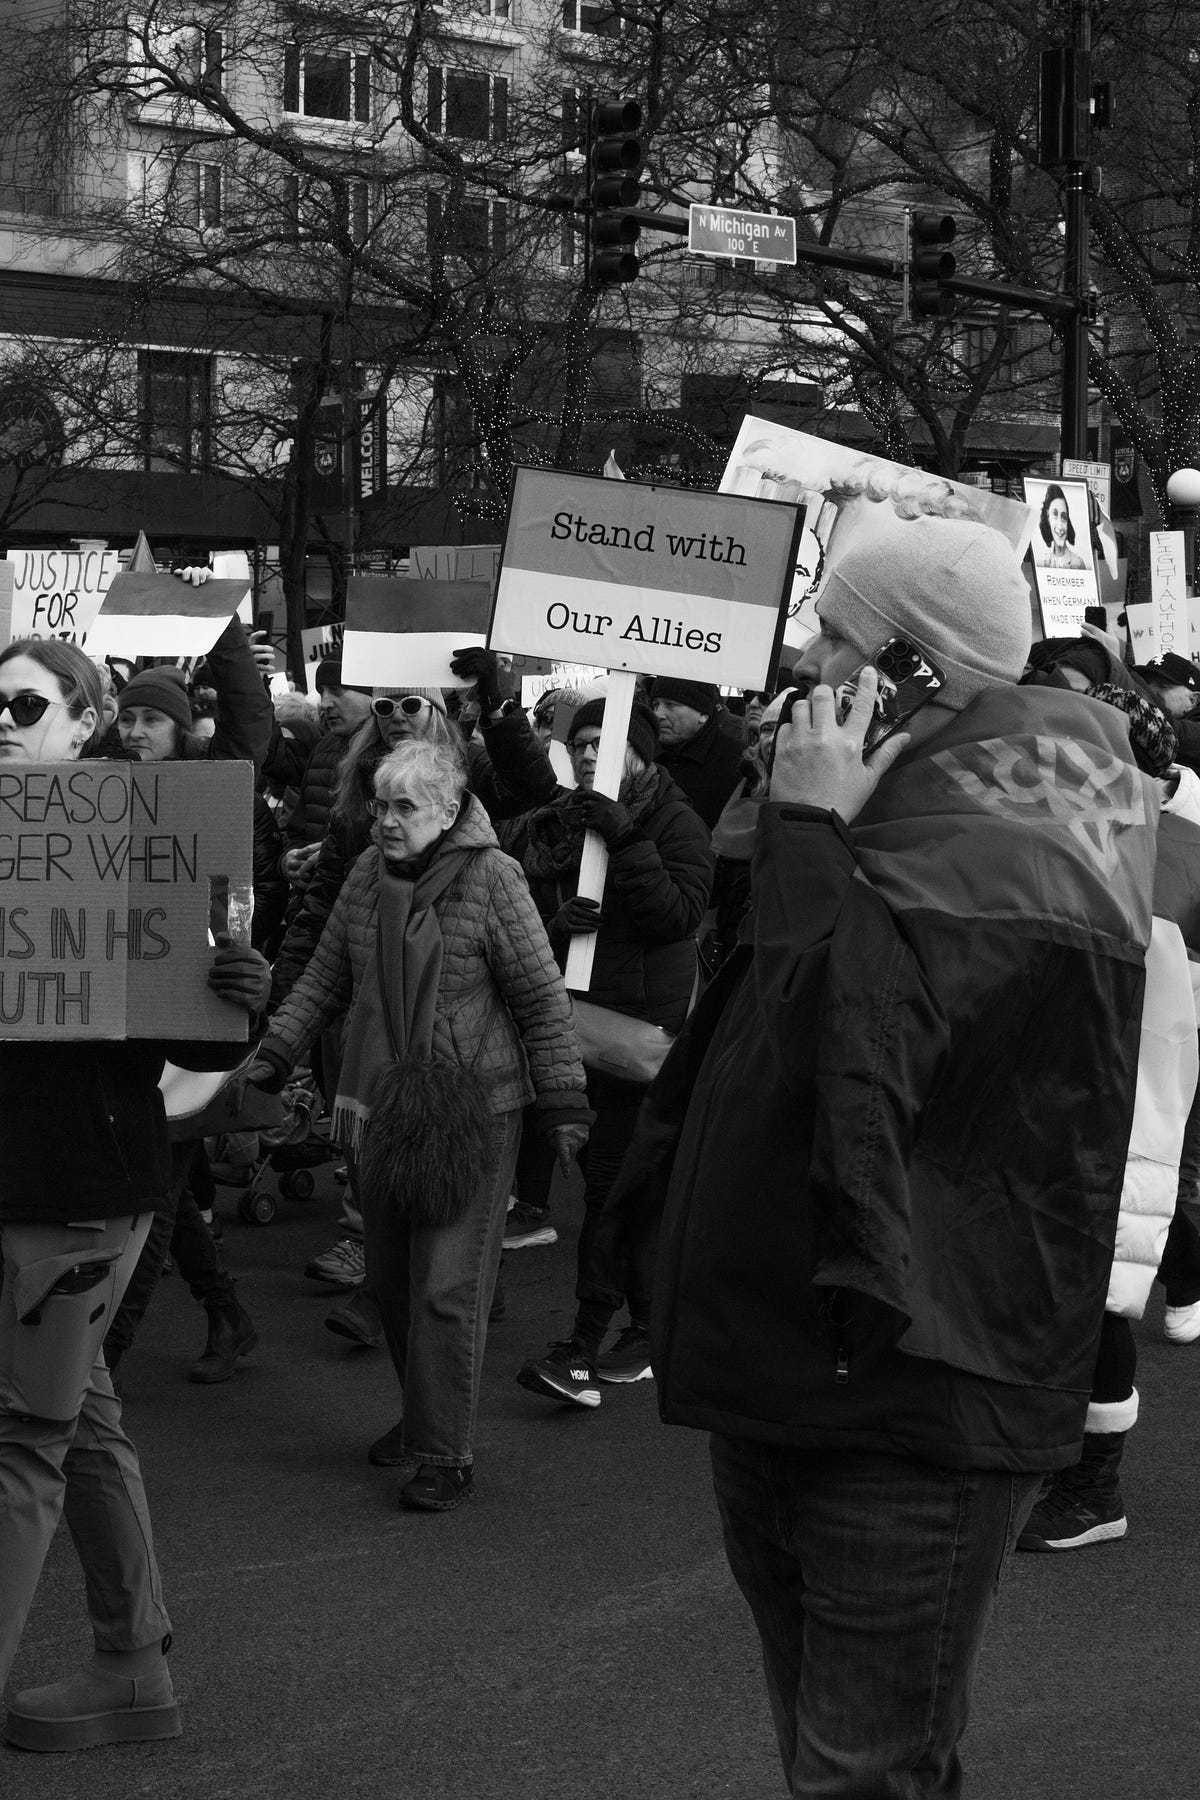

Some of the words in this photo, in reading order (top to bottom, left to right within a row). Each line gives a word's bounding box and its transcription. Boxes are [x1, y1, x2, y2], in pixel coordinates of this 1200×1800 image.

[699, 215, 707, 228] N
[710, 213, 770, 241] Michigan
[774, 225, 787, 238] Av
[728, 238, 745, 252] 100
[753, 241, 760, 254] E
[1068, 462, 1089, 474] SPEED
[1090, 465, 1107, 477] LIMIT
[551, 512, 655, 553] Stand
[666, 533, 747, 566] with
[15, 551, 113, 593] JUSTICE
[32, 592, 79, 629] FOR
[546, 602, 613, 636] Our
[619, 614, 723, 654] Allies
[531, 676, 590, 698] UKRAIN
[87, 833, 198, 883] WHEN
[0, 907, 36, 960] IS
[50, 907, 86, 960] IN
[105, 907, 171, 961] HIS
[569, 1369, 589, 1381] HOKA
